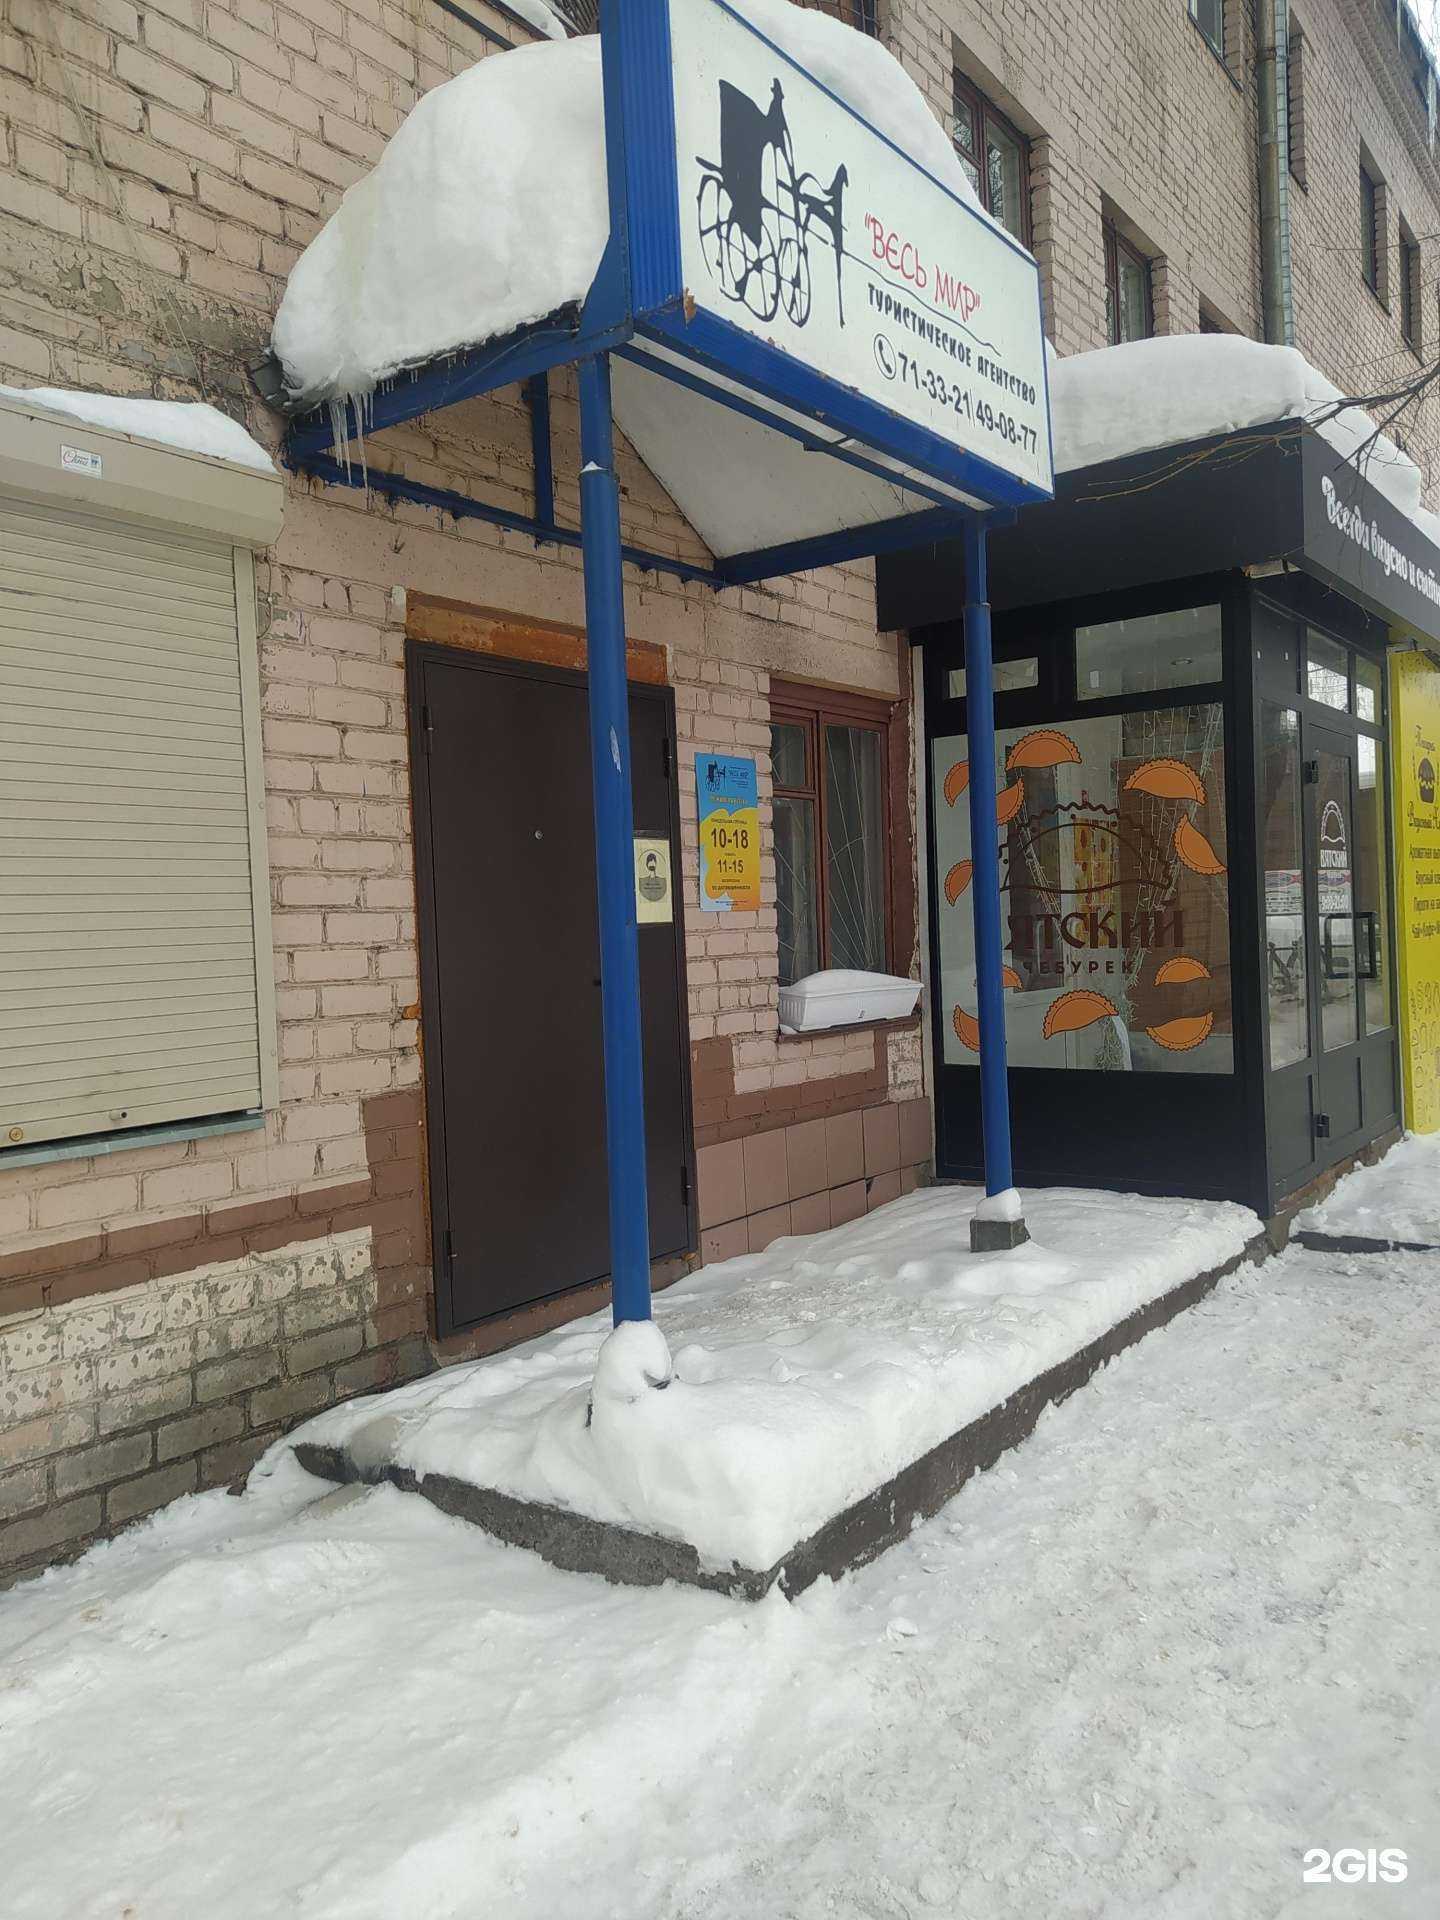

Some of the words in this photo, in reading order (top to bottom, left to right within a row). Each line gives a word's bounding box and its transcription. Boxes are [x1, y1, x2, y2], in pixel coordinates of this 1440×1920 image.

[934, 264, 981, 323] МИР"
[868, 282, 972, 368] ТУРИСТИЧЕСКОЕ
[977, 355, 1036, 406] АГЕНТСТВО
[1321, 475, 1370, 552] Всегда
[1371, 519, 1408, 580] вкусно
[711, 827, 749, 849] 10-18
[717, 859, 744, 873] 11-15
[1004, 905, 1185, 951] ЯТСКИЙ
[1023, 960, 1136, 975] ЧЕБУРЕК
